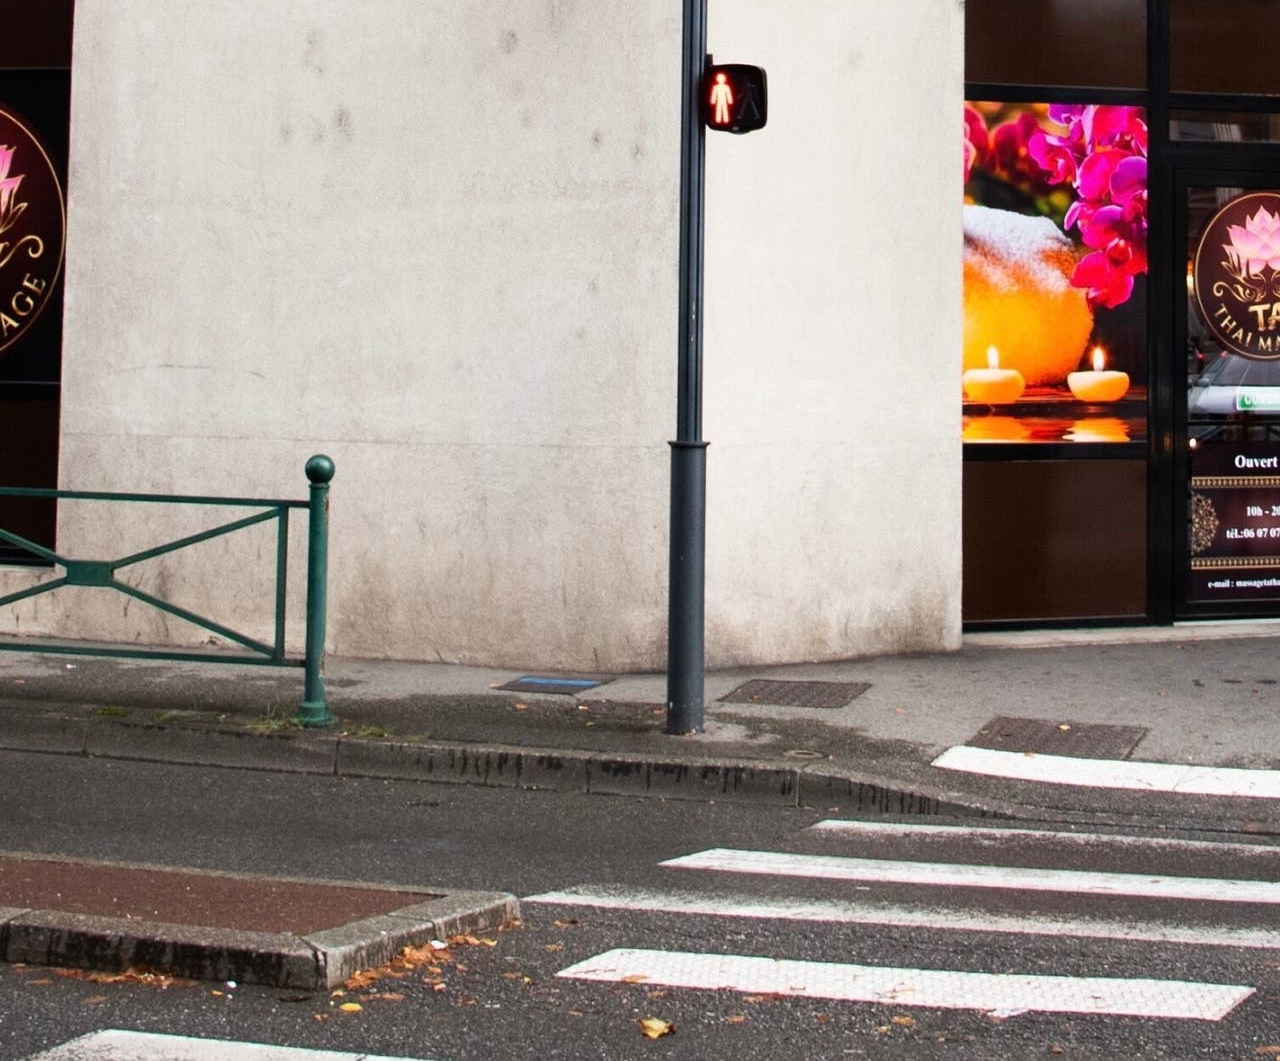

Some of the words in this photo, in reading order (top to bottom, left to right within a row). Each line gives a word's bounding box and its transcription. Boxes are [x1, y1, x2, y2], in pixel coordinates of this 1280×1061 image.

[1214, 303, 1252, 347] THAI
[1234, 454, 1278, 468] Ouvert
[1246, 506, 1263, 516] 10h
[1256, 528, 1268, 538] 07
[1270, 528, 1280, 538] 07
